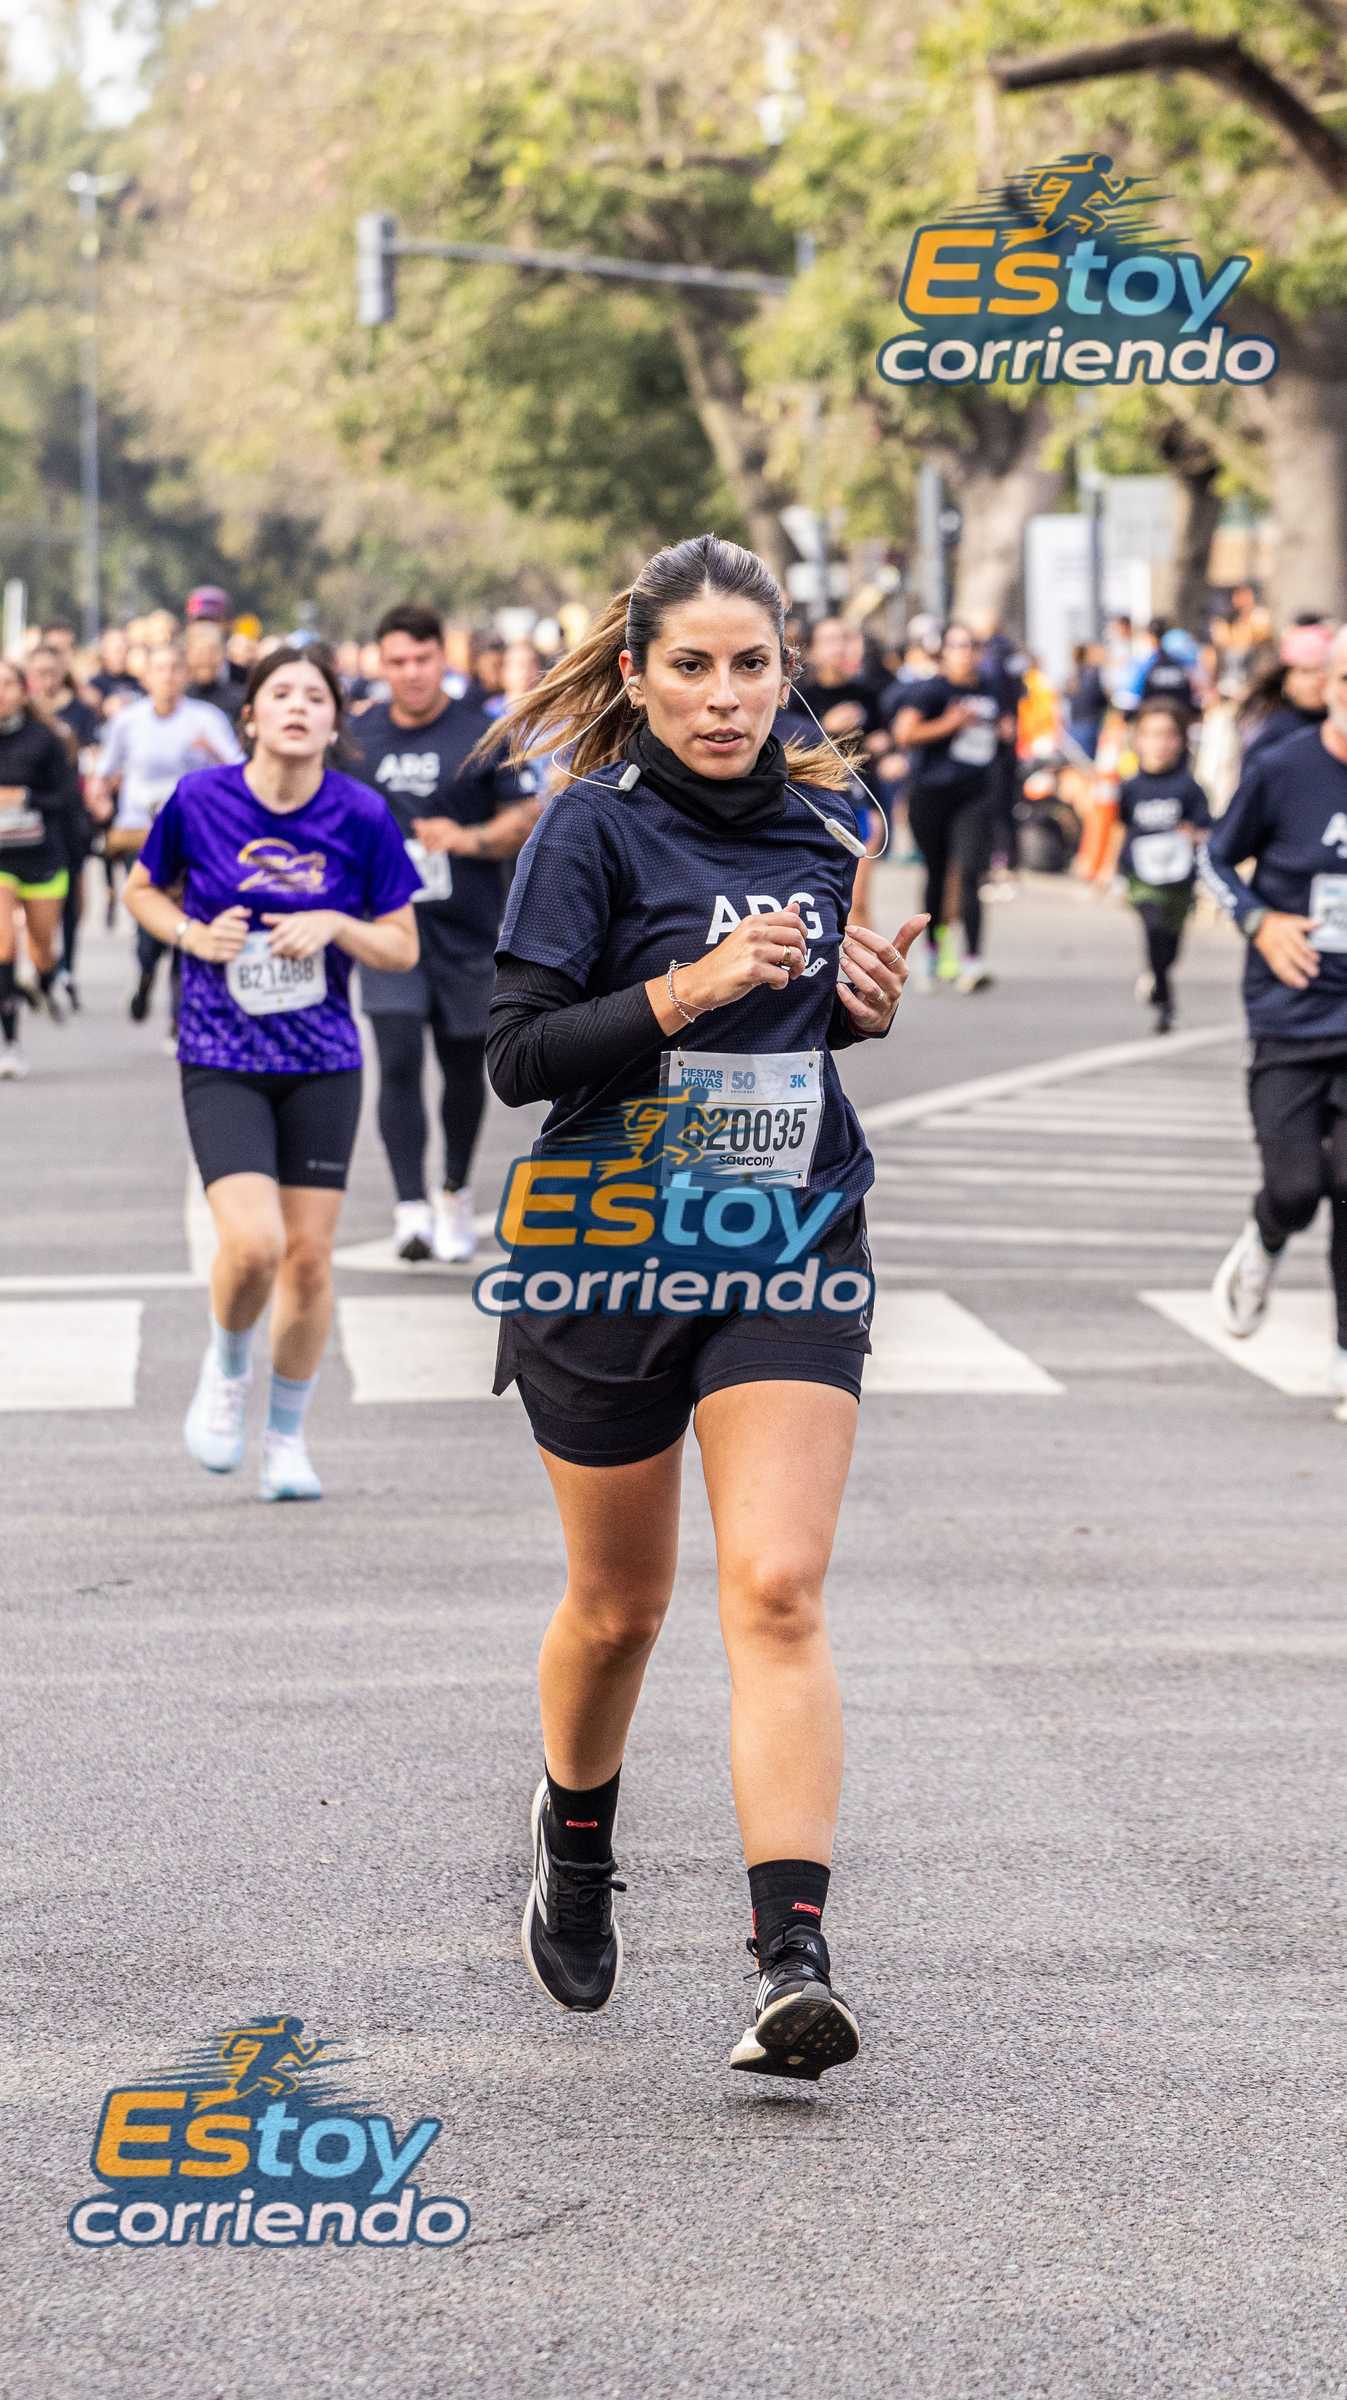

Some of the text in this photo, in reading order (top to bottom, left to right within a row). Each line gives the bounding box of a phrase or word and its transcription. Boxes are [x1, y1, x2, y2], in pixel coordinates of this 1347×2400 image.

[681, 1067, 724, 1080] FIESTAS
[731, 1071, 756, 1089] 50
[680, 1078, 723, 1089] MAYAS
[789, 1074, 807, 1088] 3K
[719, 1155, 775, 1168] saucony
